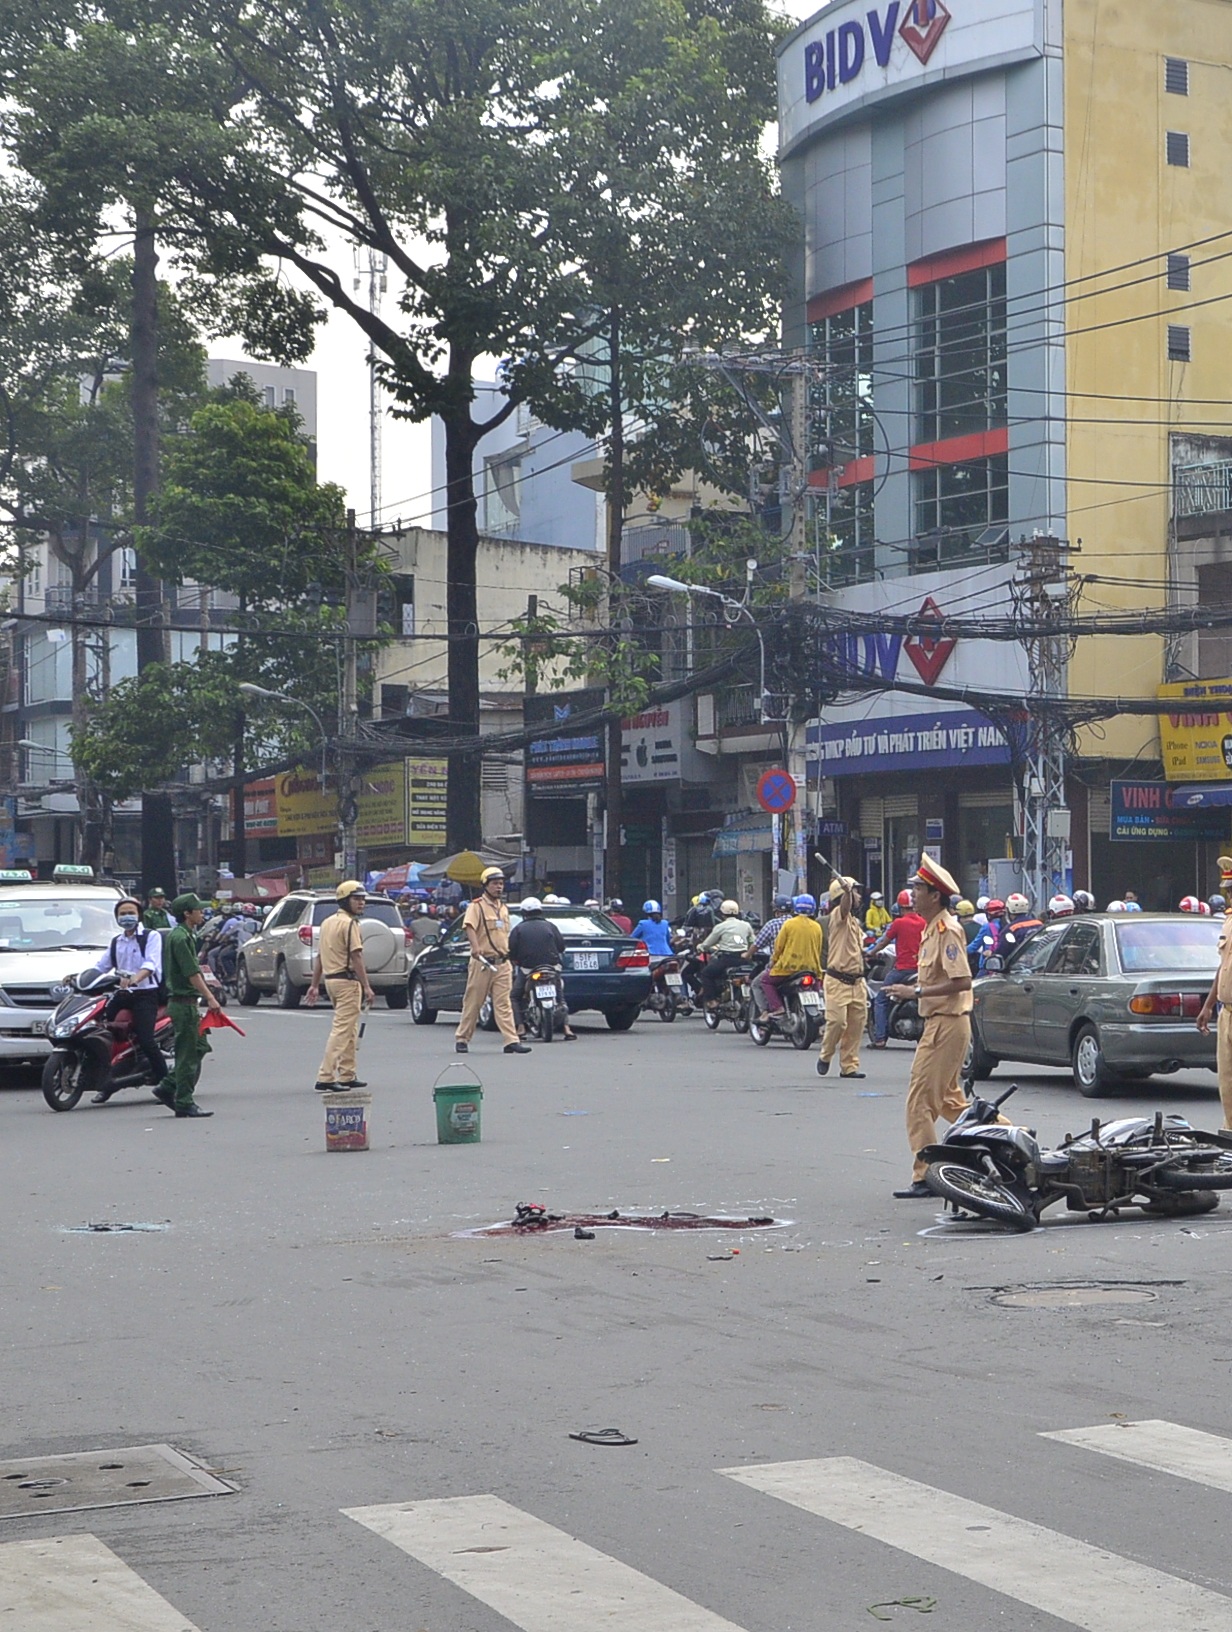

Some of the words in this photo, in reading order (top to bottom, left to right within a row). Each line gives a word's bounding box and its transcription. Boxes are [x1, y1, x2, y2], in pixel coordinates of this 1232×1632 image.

[804, 1, 899, 104] BIDV
[949, 723, 976, 753] VIỆT
[1121, 786, 1160, 809] VINH
[823, 822, 844, 833] ATM
[1, 871, 29, 879] TAXI
[58, 865, 90, 874] TAXI
